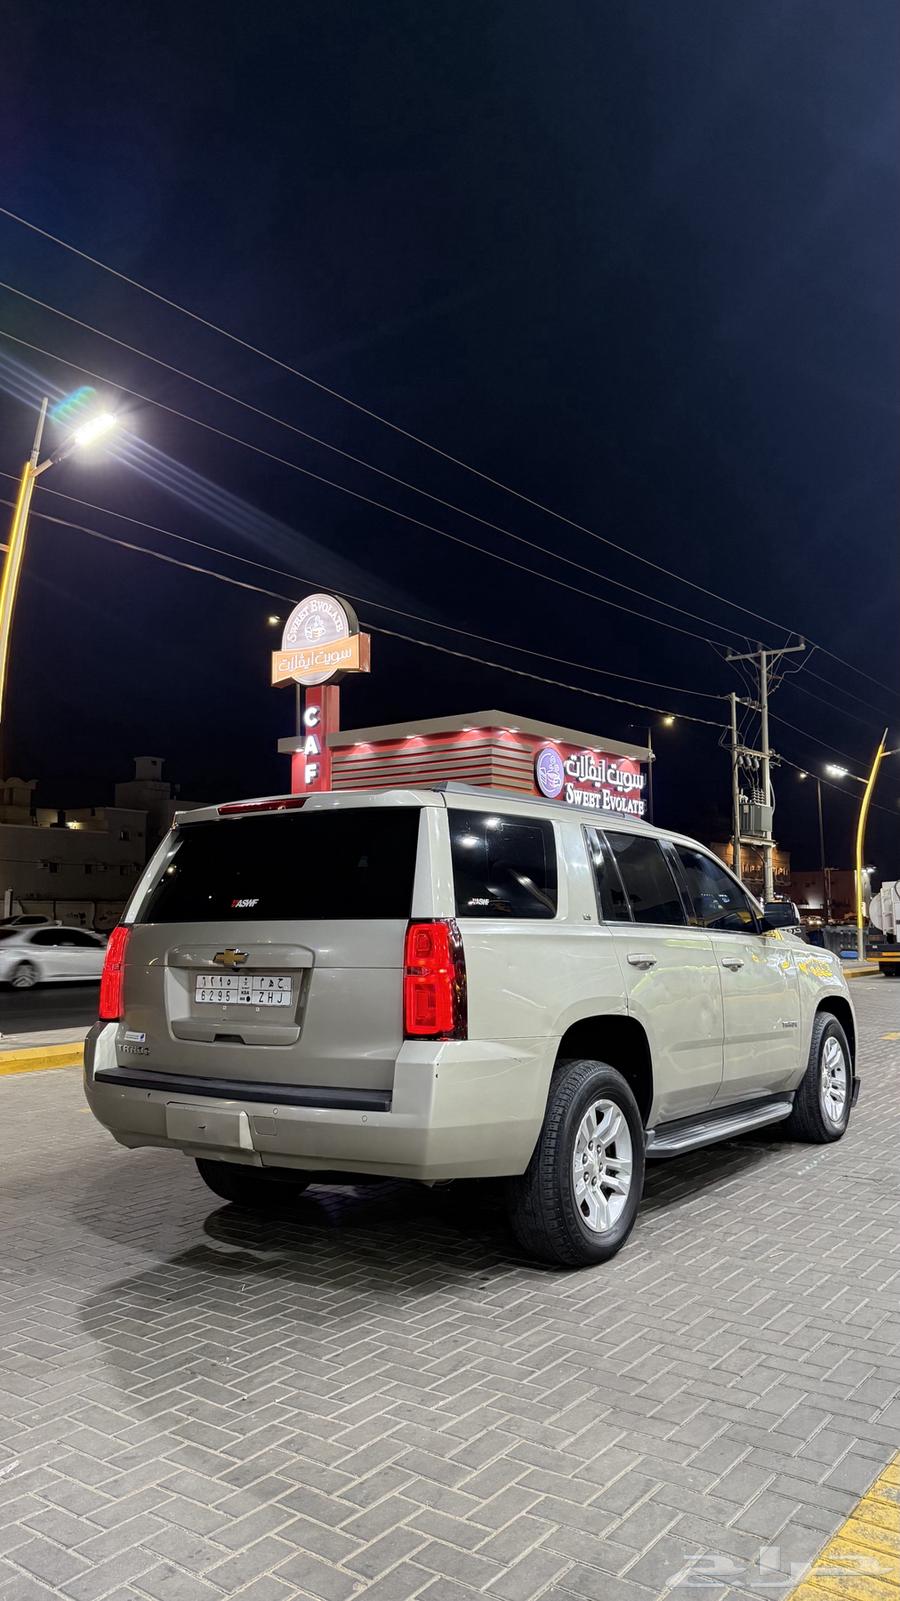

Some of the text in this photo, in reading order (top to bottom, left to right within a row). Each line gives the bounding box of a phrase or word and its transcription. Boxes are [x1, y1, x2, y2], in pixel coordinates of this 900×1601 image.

[287, 600, 344, 643] SWEET EVOLATE
[315, 647, 352, 665] سويت
[606, 763, 645, 792] سويت
[565, 782, 645, 815] SWEET EVOLATE
[201, 990, 231, 1002] 6295
